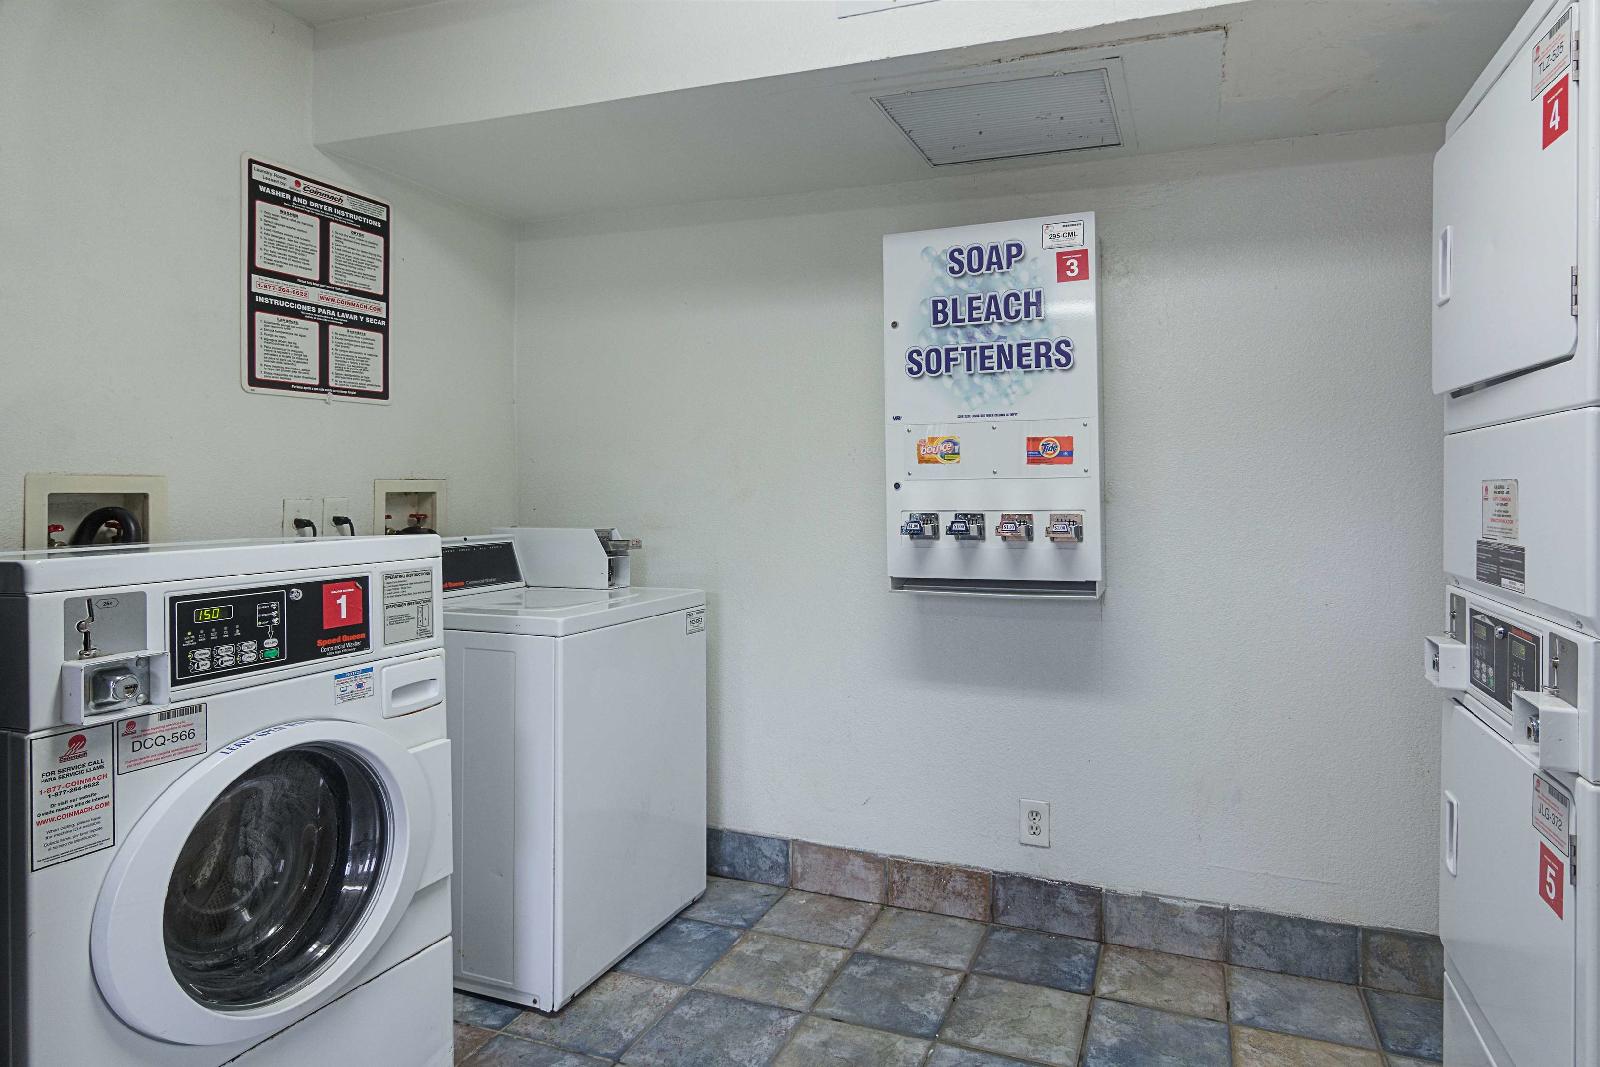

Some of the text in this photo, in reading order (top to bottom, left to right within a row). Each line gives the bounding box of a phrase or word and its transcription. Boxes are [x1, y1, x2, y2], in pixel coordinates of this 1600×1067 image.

[1549, 98, 1560, 131] 4
[254, 167, 288, 181] Laundry Room
[258, 184, 291, 200] WASHER
[293, 196, 307, 206] AND
[309, 201, 333, 214] DRYER
[334, 209, 382, 228] INSTRUCTIONS
[302, 184, 344, 204] Coinmach
[948, 241, 1024, 275] SOAP
[1065, 258, 1079, 277] 3
[255, 295, 316, 313] INSTRUCCIONES
[317, 307, 336, 318] PARA
[336, 311, 358, 322] LAVAR
[359, 315, 364, 323] Y
[365, 317, 385, 328] SECAR
[931, 289, 1043, 326] BLEACH
[906, 338, 1074, 376] SOFTENERS
[1041, 441, 1059, 455] Tide
[199, 608, 220, 621] 150
[336, 594, 347, 619] 1
[316, 633, 366, 648] Speed Queen
[131, 728, 196, 753] DCQ-566
[41, 758, 105, 779] FOR SERVICE CALL
[39, 773, 108, 796] 1-877-COINMACH
[36, 801, 111, 827] WWW.COINMACH.COM
[1545, 864, 1557, 900] 5
